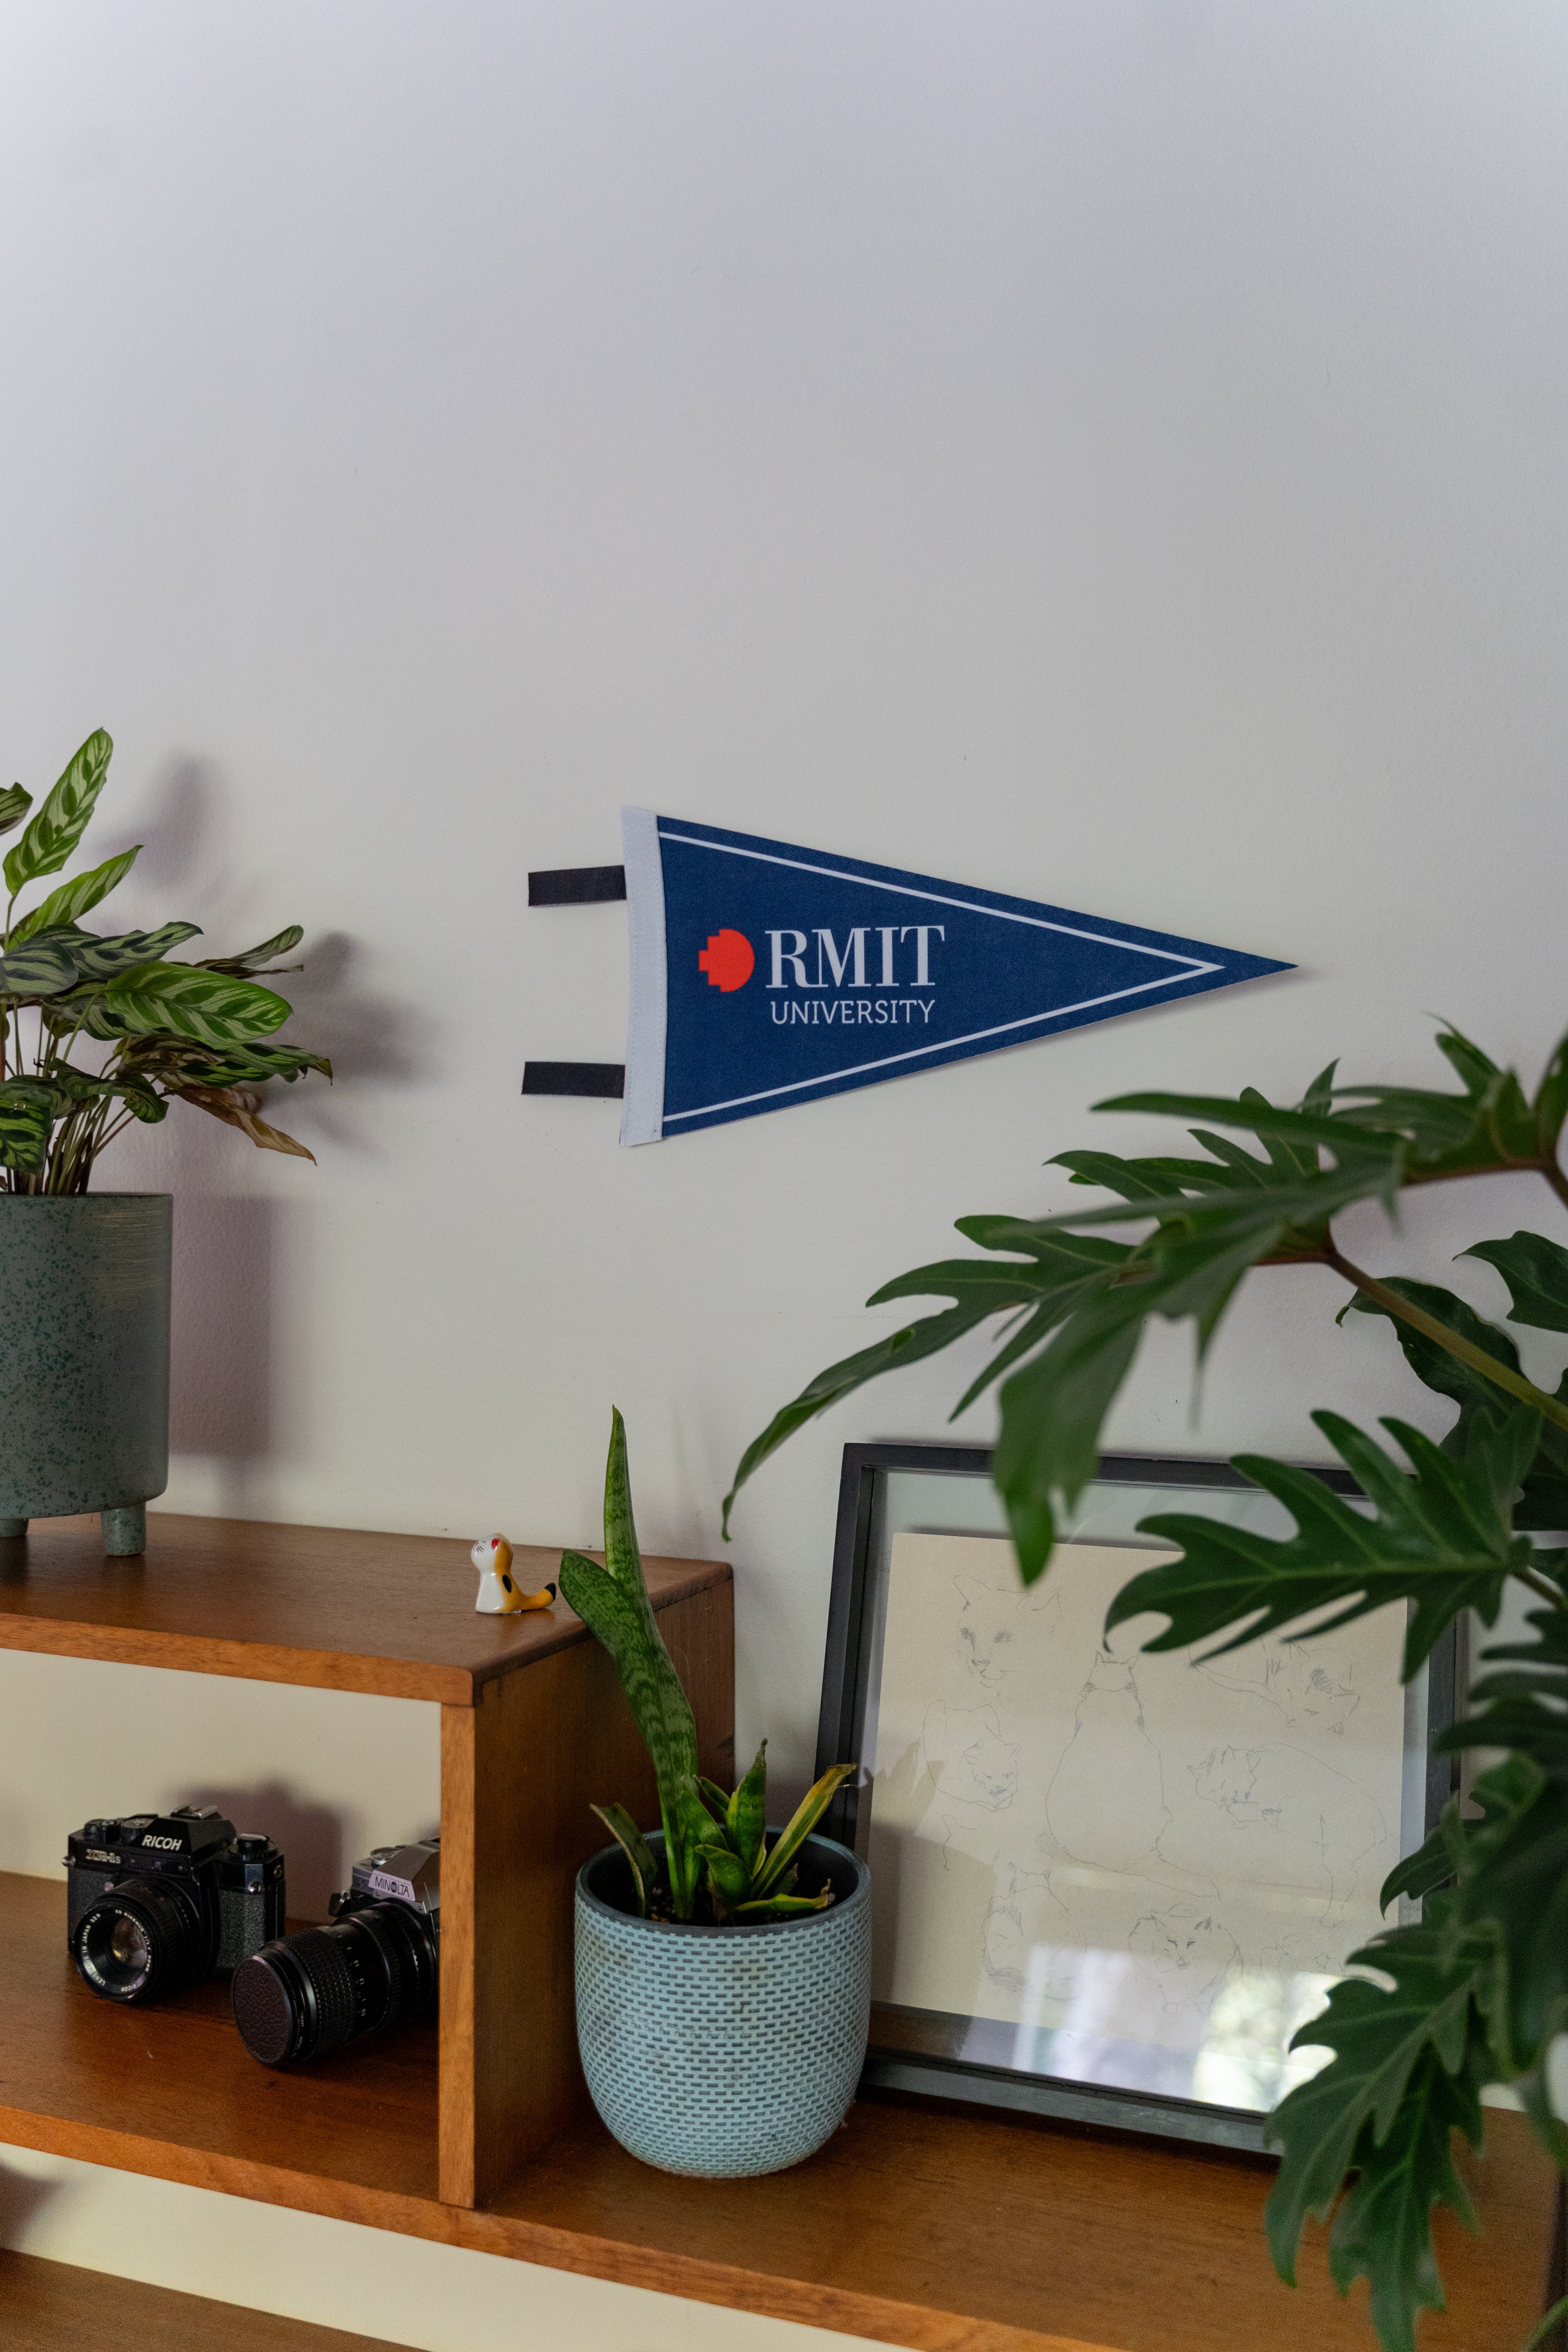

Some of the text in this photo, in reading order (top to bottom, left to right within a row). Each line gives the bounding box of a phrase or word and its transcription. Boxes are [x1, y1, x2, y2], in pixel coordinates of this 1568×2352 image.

[764, 925, 945, 988] RMIT
[770, 1000, 935, 1024] UNIVERSITY
[142, 1835, 182, 1851] RICOH
[375, 1876, 410, 1897] MINOLTA
[81, 1924, 91, 1944] JAPAN
